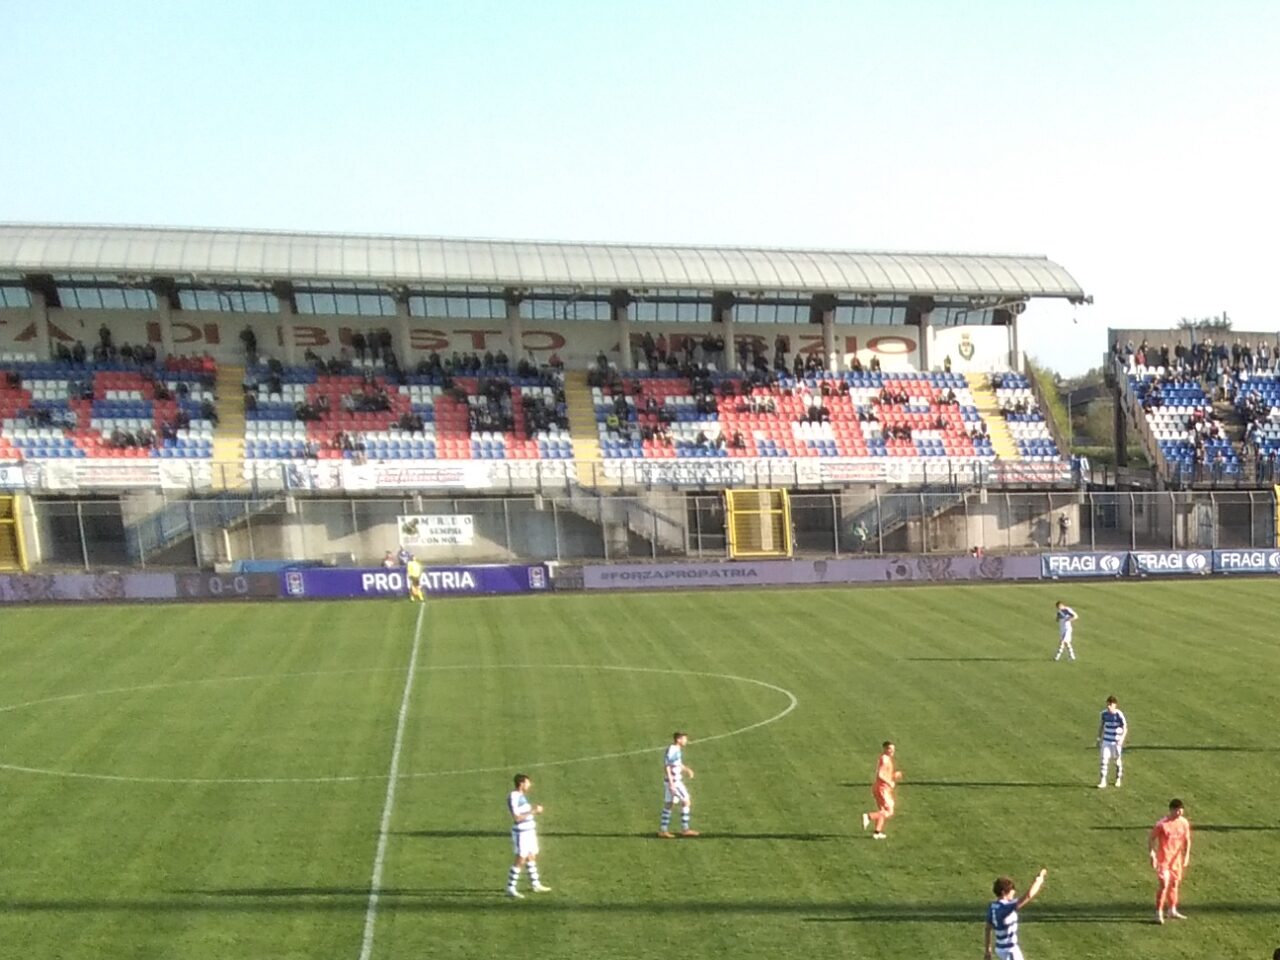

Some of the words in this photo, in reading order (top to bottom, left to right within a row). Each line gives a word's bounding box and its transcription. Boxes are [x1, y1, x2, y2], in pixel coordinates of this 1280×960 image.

[1049, 555, 1096, 571] FRAGI
[1138, 554, 1183, 569] FRAGI
[1221, 552, 1265, 567] FRAGI
[361, 571, 402, 592] PRO
[406, 570, 475, 591] ATRIA
[600, 568, 758, 581] #FORZAPROPATRIA
[208, 576, 248, 594] 0-0
